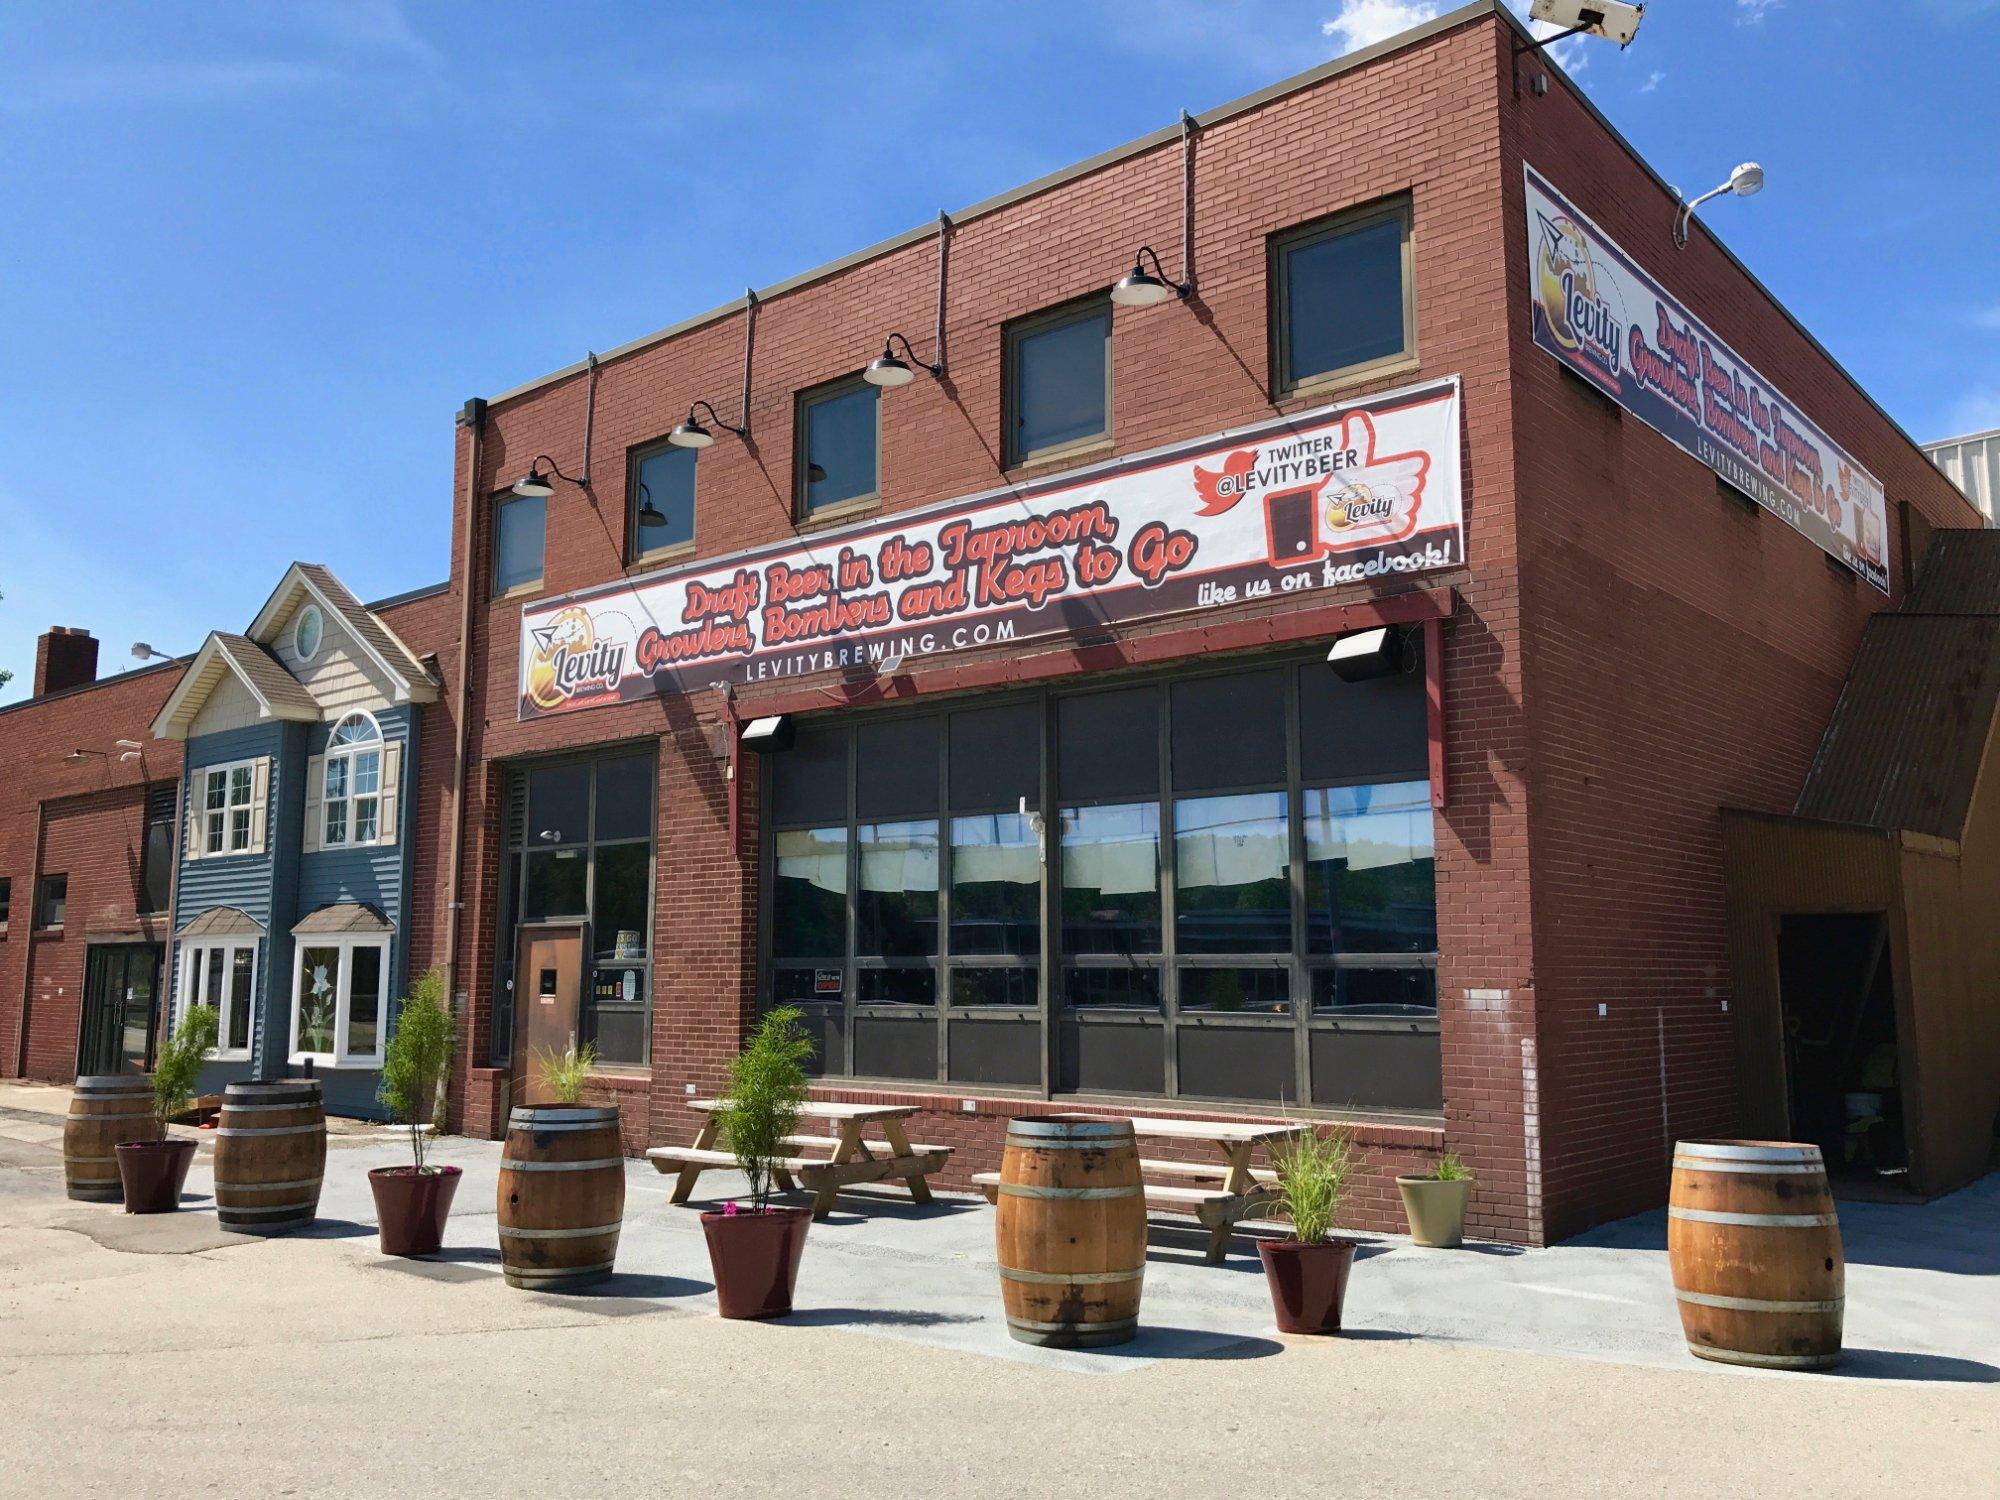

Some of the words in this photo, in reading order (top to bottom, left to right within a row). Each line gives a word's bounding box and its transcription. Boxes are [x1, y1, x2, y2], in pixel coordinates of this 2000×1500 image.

[1561, 271, 1621, 373] Levity
[1657, 302, 1699, 380] Draft
[1701, 342, 1733, 404] Beer
[1734, 370, 1749, 419] in
[1750, 387, 1770, 436] the
[1217, 449, 1358, 495] @LEVITYBEER
[1268, 436, 1332, 463] TWITTER
[1697, 436, 1801, 526] LEVITYBREWING.COM
[1703, 386, 1758, 463] Bombers
[1760, 441, 1784, 484] and
[1786, 451, 1812, 508] Kegs
[1344, 498, 1393, 523] Levity
[638, 622, 753, 671] Growlers,
[764, 592, 890, 644] Bombers
[900, 572, 967, 618] and
[977, 560, 1066, 607] Kegs
[1077, 543, 1119, 584] to
[1130, 524, 1196, 581] Go
[683, 571, 759, 622] Draft
[767, 565, 831, 602] Beer
[839, 549, 872, 590] in
[880, 538, 932, 577] the
[941, 503, 1117, 567] Taproom,
[1198, 582, 1237, 606] like
[1245, 578, 1272, 596] us
[1280, 572, 1312, 591] on
[1322, 539, 1451, 587] facebook!
[553, 641, 625, 695] Levity
[746, 619, 1016, 682] LEVITYBREWING.COM
